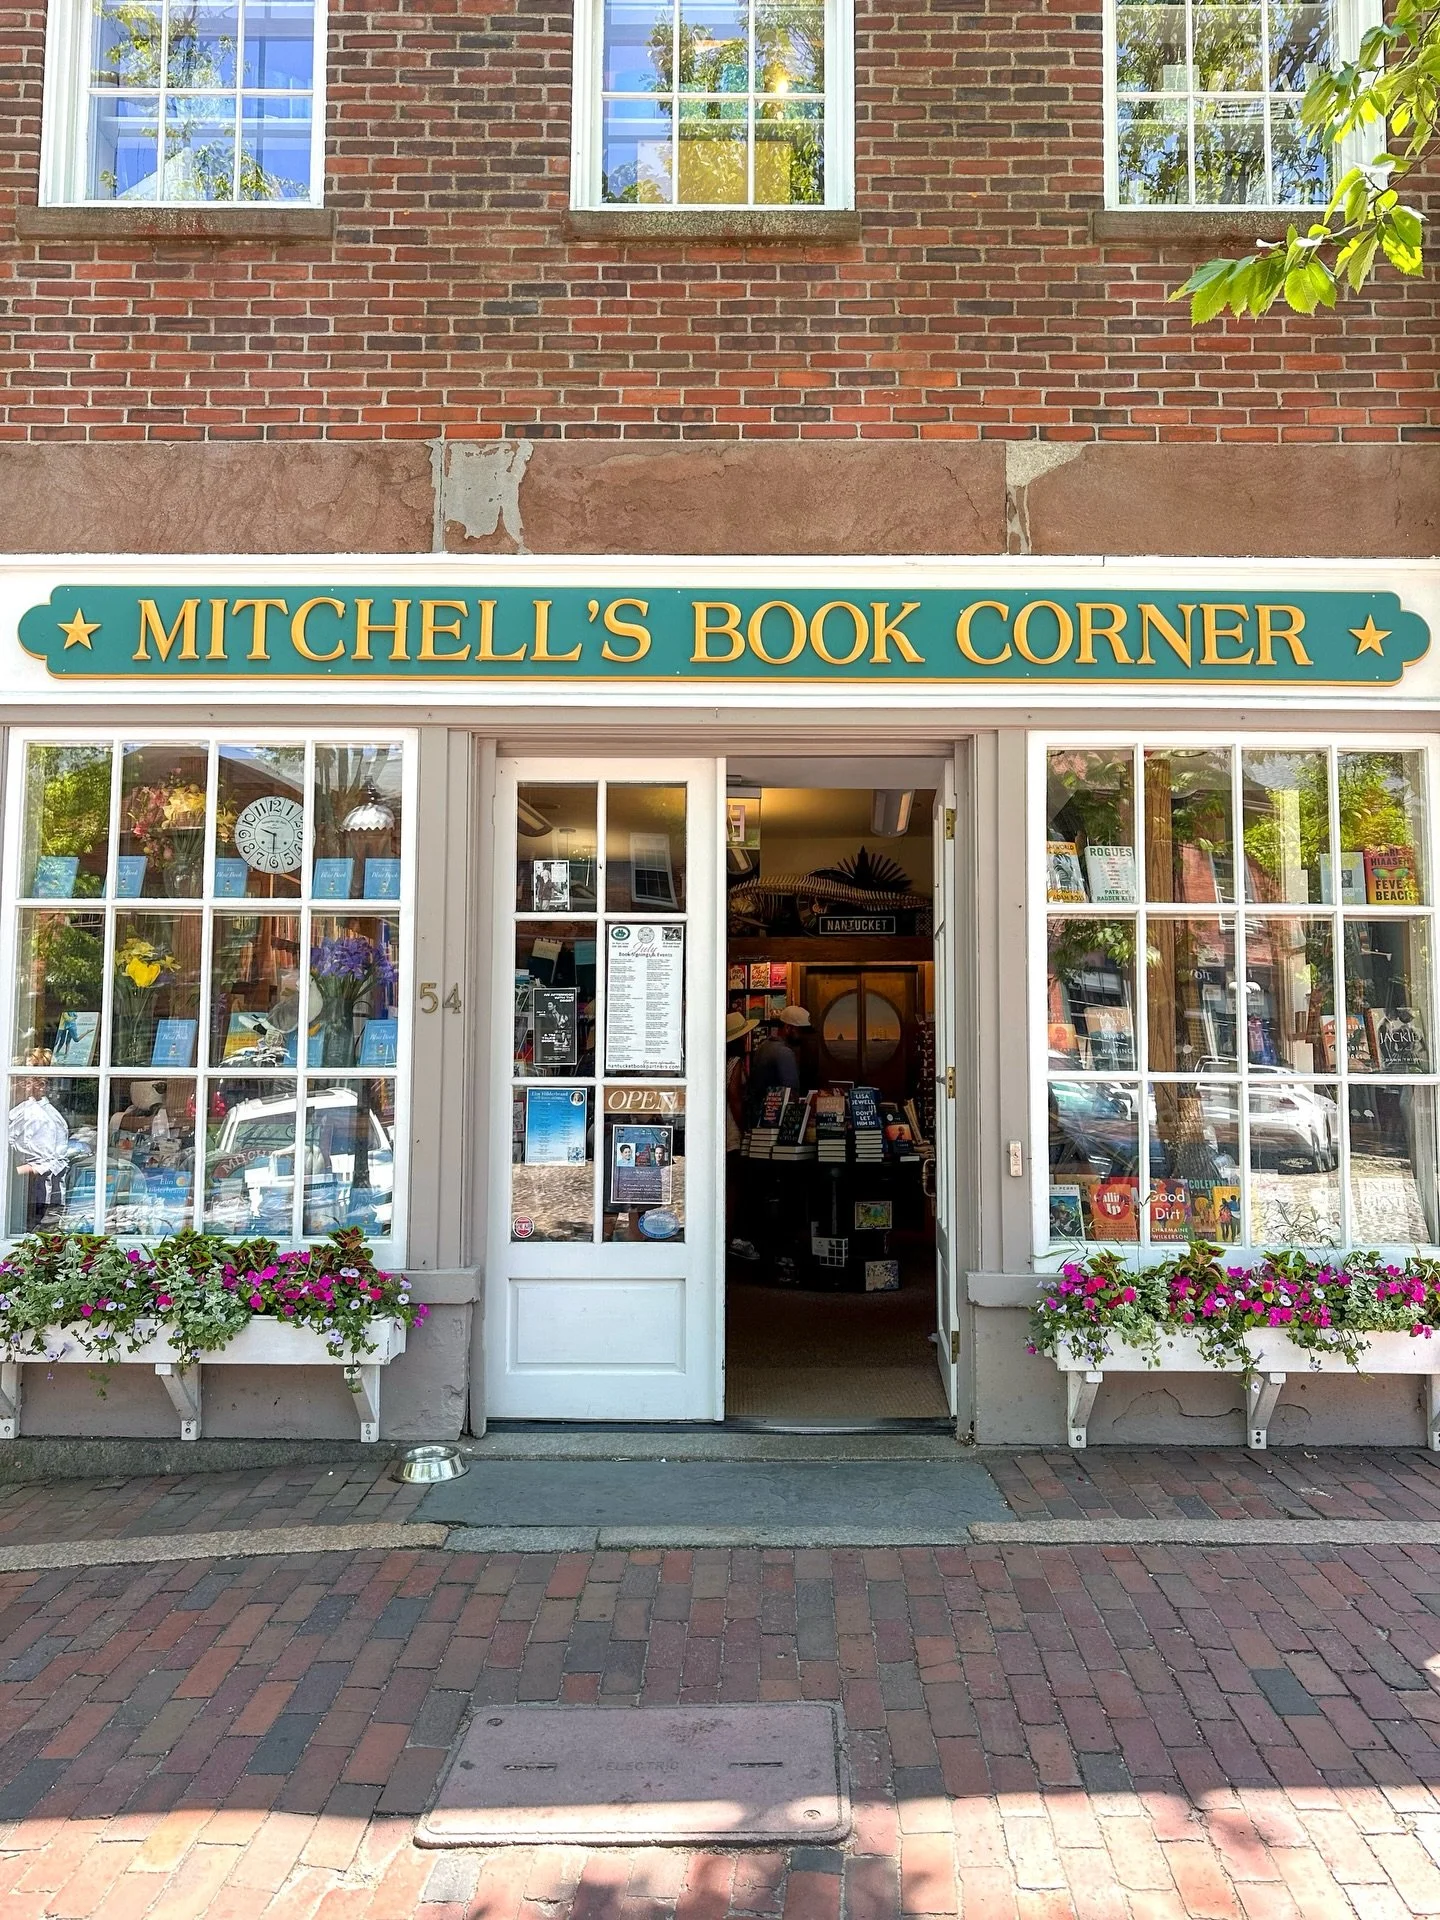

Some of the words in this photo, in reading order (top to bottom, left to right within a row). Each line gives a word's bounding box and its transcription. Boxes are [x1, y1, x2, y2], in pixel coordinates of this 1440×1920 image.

[132, 596, 652, 664] MITCHELL'S
[689, 600, 926, 666] BOOK
[956, 600, 1315, 669] CORNER
[254, 803, 267, 817] 11
[269, 799, 282, 813] 12
[286, 804, 295, 816] 1
[242, 813, 256, 827] 10
[238, 829, 252, 839] 9
[243, 842, 255, 854] 8
[1089, 847, 1133, 857] ROGUES
[256, 851, 265, 866] 7
[268, 855, 279, 869] 6
[283, 852, 294, 866] 5
[827, 919, 888, 931] NANTUCKET
[420, 982, 462, 1014] 54
[608, 1090, 678, 1110] OPEN
[1150, 1188, 1185, 1202] Good
[1155, 1207, 1180, 1220] Dirt
[606, 1761, 679, 1771] ELECTRIC
